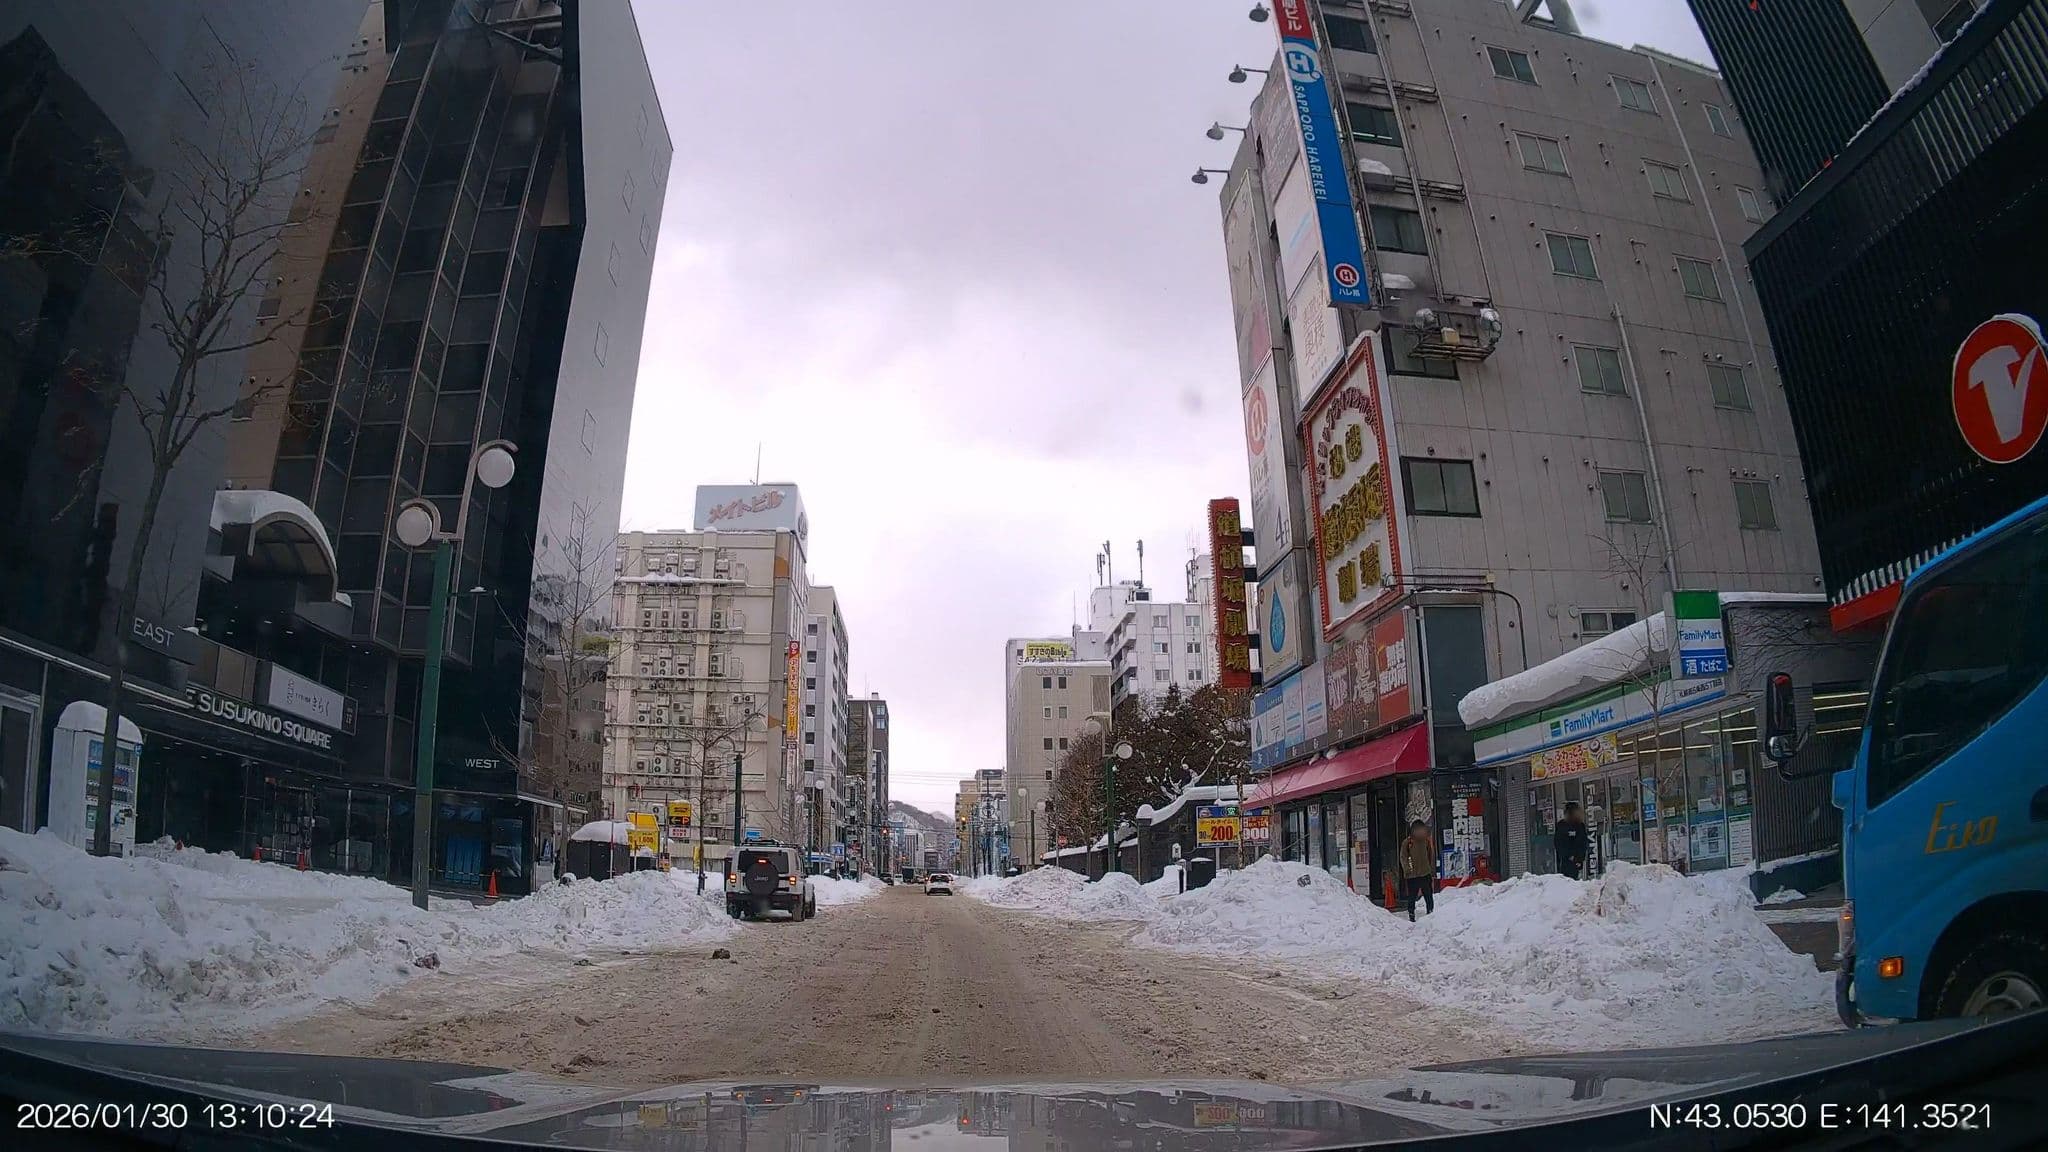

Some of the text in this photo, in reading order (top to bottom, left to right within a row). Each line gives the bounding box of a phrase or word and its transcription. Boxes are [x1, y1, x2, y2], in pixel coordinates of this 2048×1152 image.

[1294, 84, 1327, 200] SAPPORO HAREKEI
[133, 617, 175, 647] EAST
[1679, 629, 1722, 642] FamilyMart
[1686, 659, 1723, 675] 酒 たばこ
[198, 693, 333, 749] SUSUKINO SQUARE
[1563, 706, 1614, 733] FamilyMart
[465, 758, 500, 769] WEST
